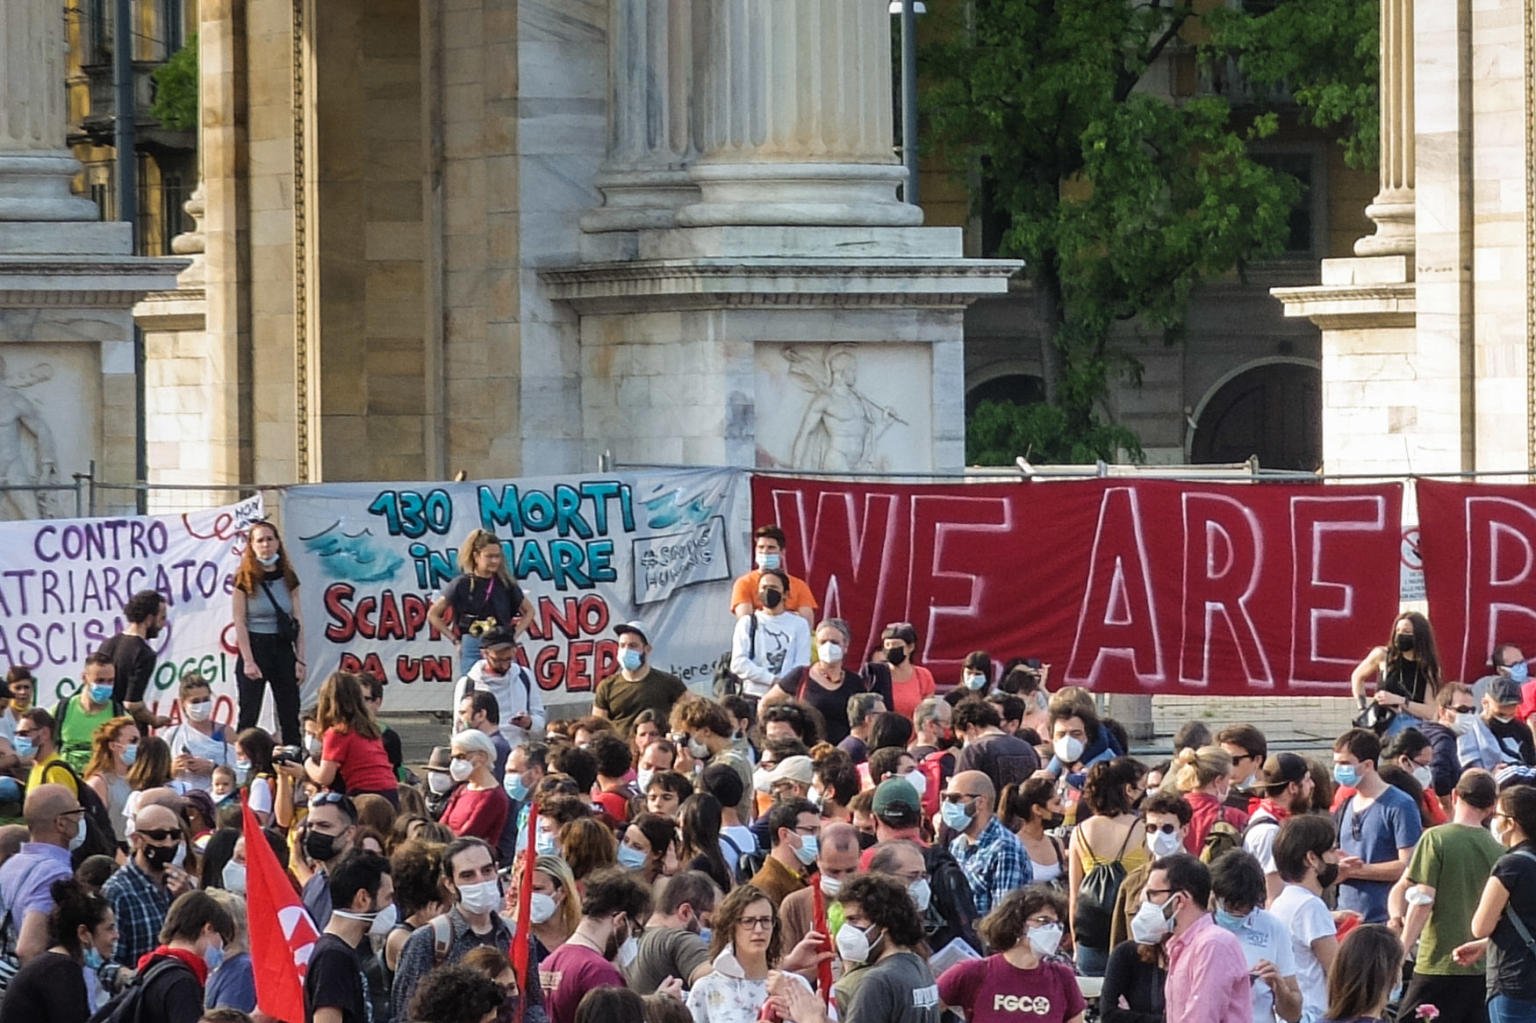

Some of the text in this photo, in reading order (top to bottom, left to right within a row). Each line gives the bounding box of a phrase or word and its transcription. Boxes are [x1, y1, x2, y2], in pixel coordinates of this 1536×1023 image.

[368, 481, 635, 539] 130 MORTI
[34, 520, 168, 562] CONTRO
[500, 539, 617, 590] ARE
[772, 489, 1011, 688] WE
[1064, 485, 1386, 689] ARE
[396, 654, 452, 683] UN
